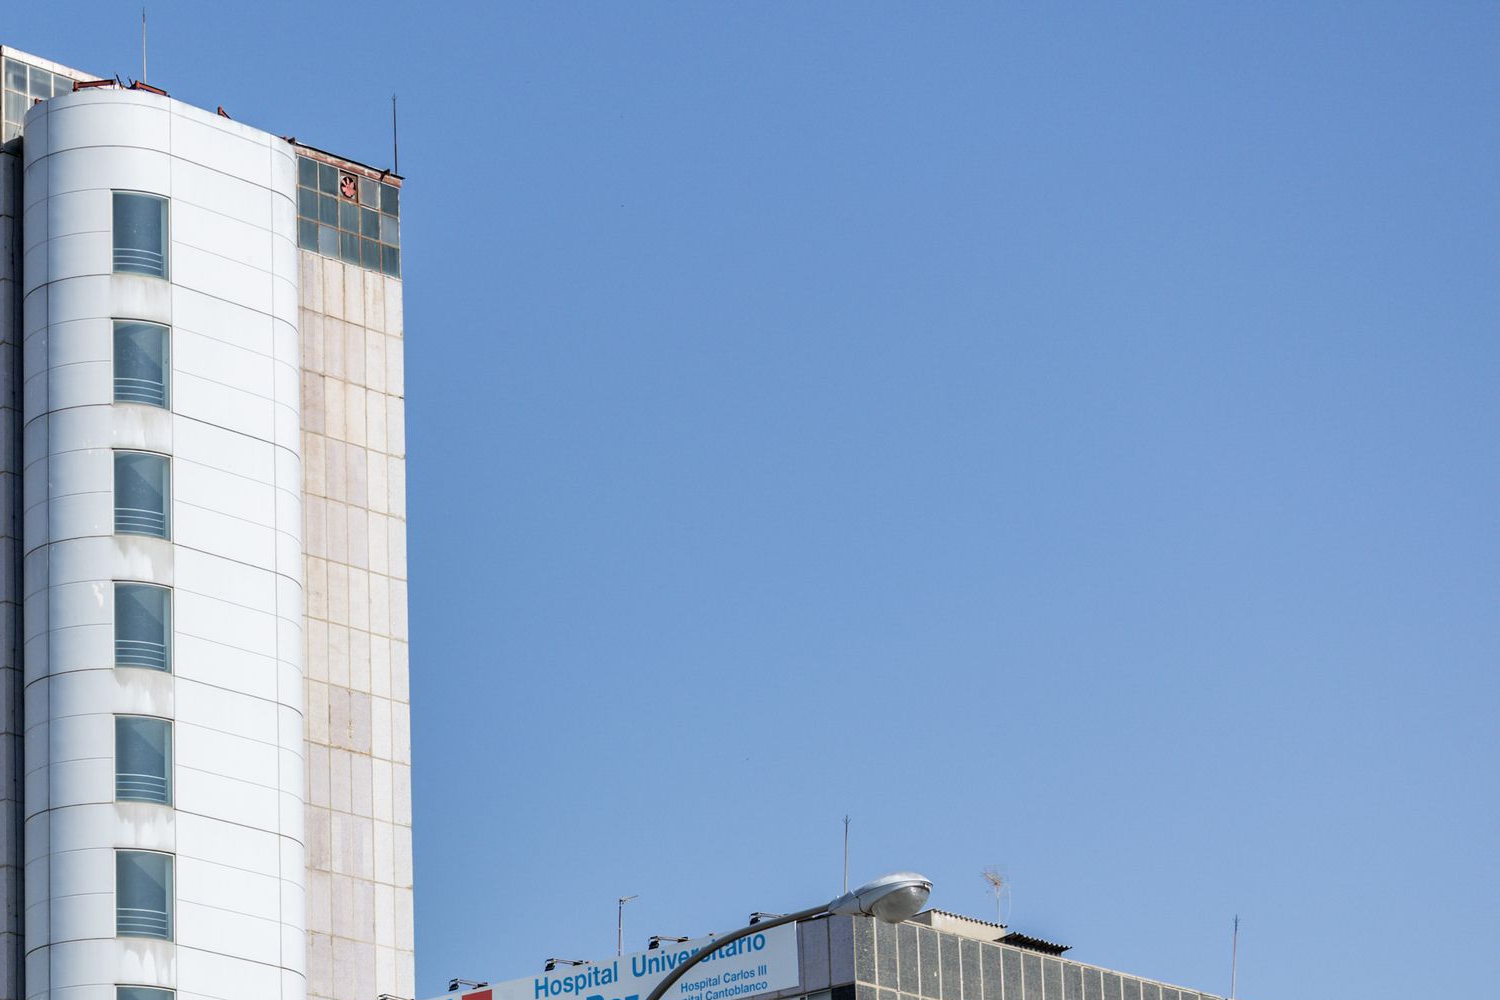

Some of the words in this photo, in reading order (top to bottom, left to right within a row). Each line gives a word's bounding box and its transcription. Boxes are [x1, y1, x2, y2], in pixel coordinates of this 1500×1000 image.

[535, 961, 618, 999] Hospital
[680, 974, 721, 993] Hospital
[723, 969, 755, 984] Carlos
[758, 964, 767, 977] III
